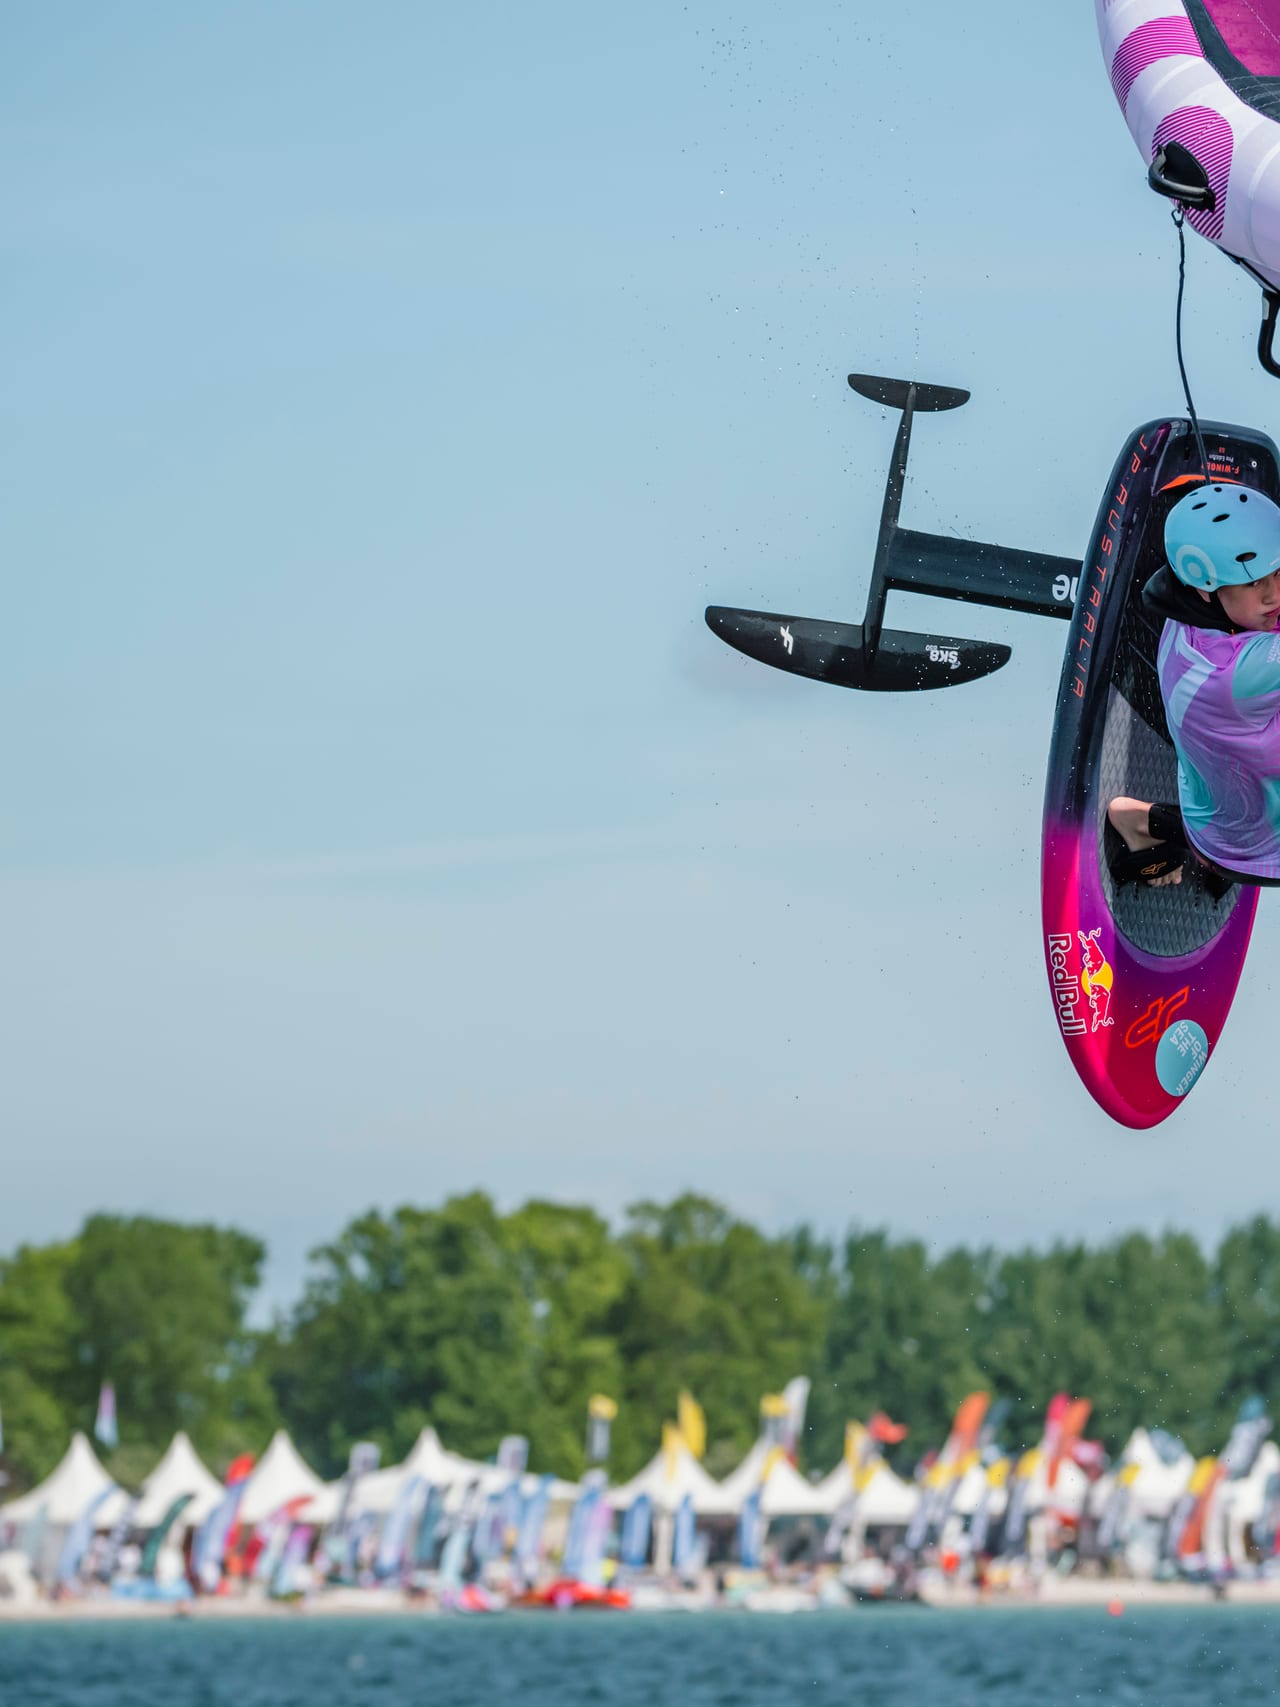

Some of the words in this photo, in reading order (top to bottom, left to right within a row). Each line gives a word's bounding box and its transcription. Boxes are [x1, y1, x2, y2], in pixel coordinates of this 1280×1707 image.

[929, 649, 958, 663] SK8
[1048, 933, 1079, 984] Red
[1055, 986, 1087, 1036] Bull
[1169, 1021, 1189, 1045] SEA
[1178, 1033, 1196, 1057] THE
[1187, 1041, 1202, 1060] OF
[1176, 1051, 1208, 1096] WINGER
